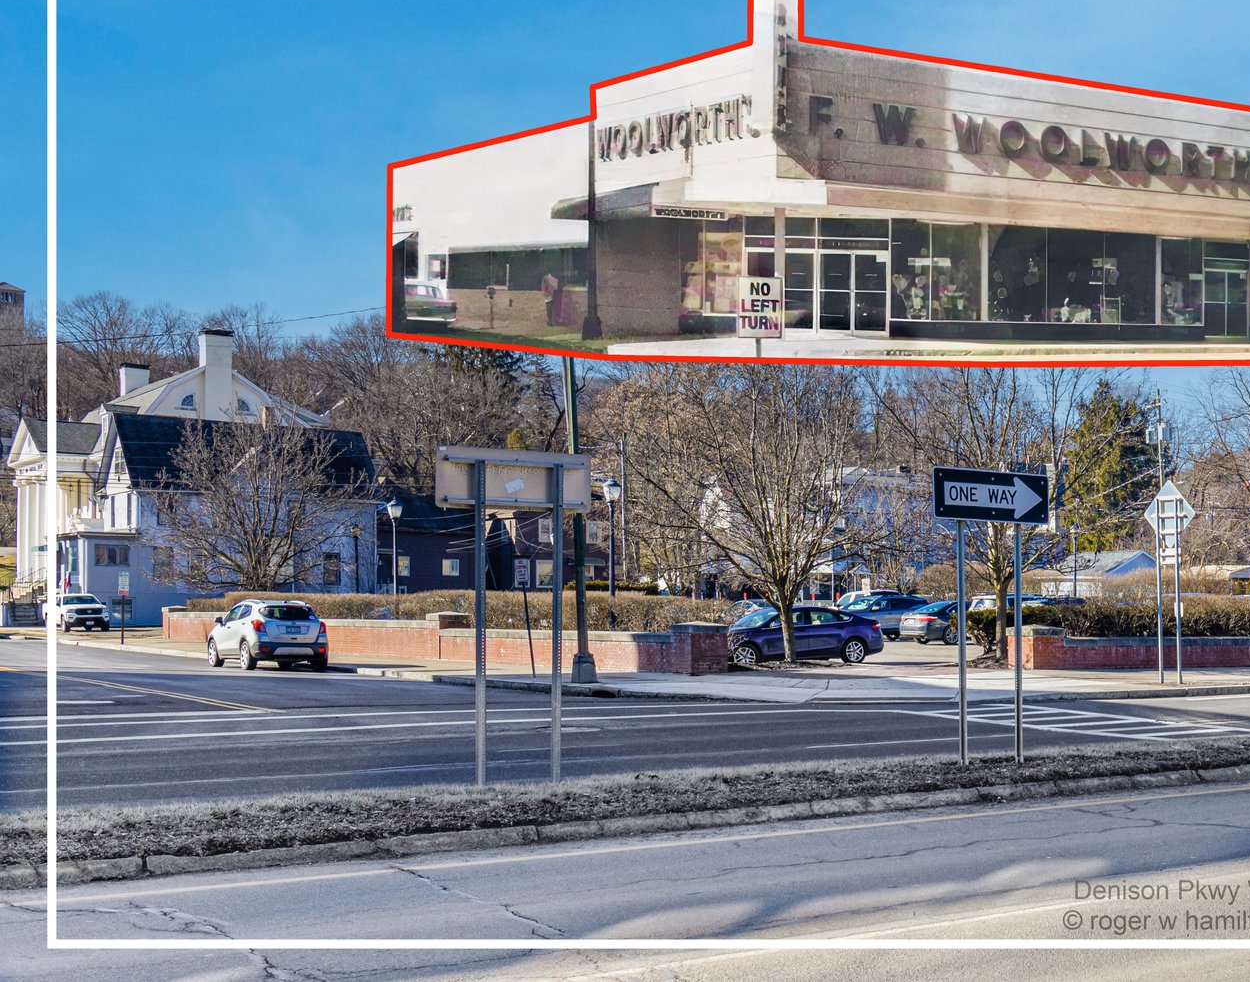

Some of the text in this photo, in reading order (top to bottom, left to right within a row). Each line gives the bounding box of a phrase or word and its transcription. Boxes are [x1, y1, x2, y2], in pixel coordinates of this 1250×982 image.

[750, 282, 771, 296] NO
[741, 299, 780, 313] LEFT
[739, 315, 779, 330] TURN
[949, 485, 1018, 505] ONE WAY
